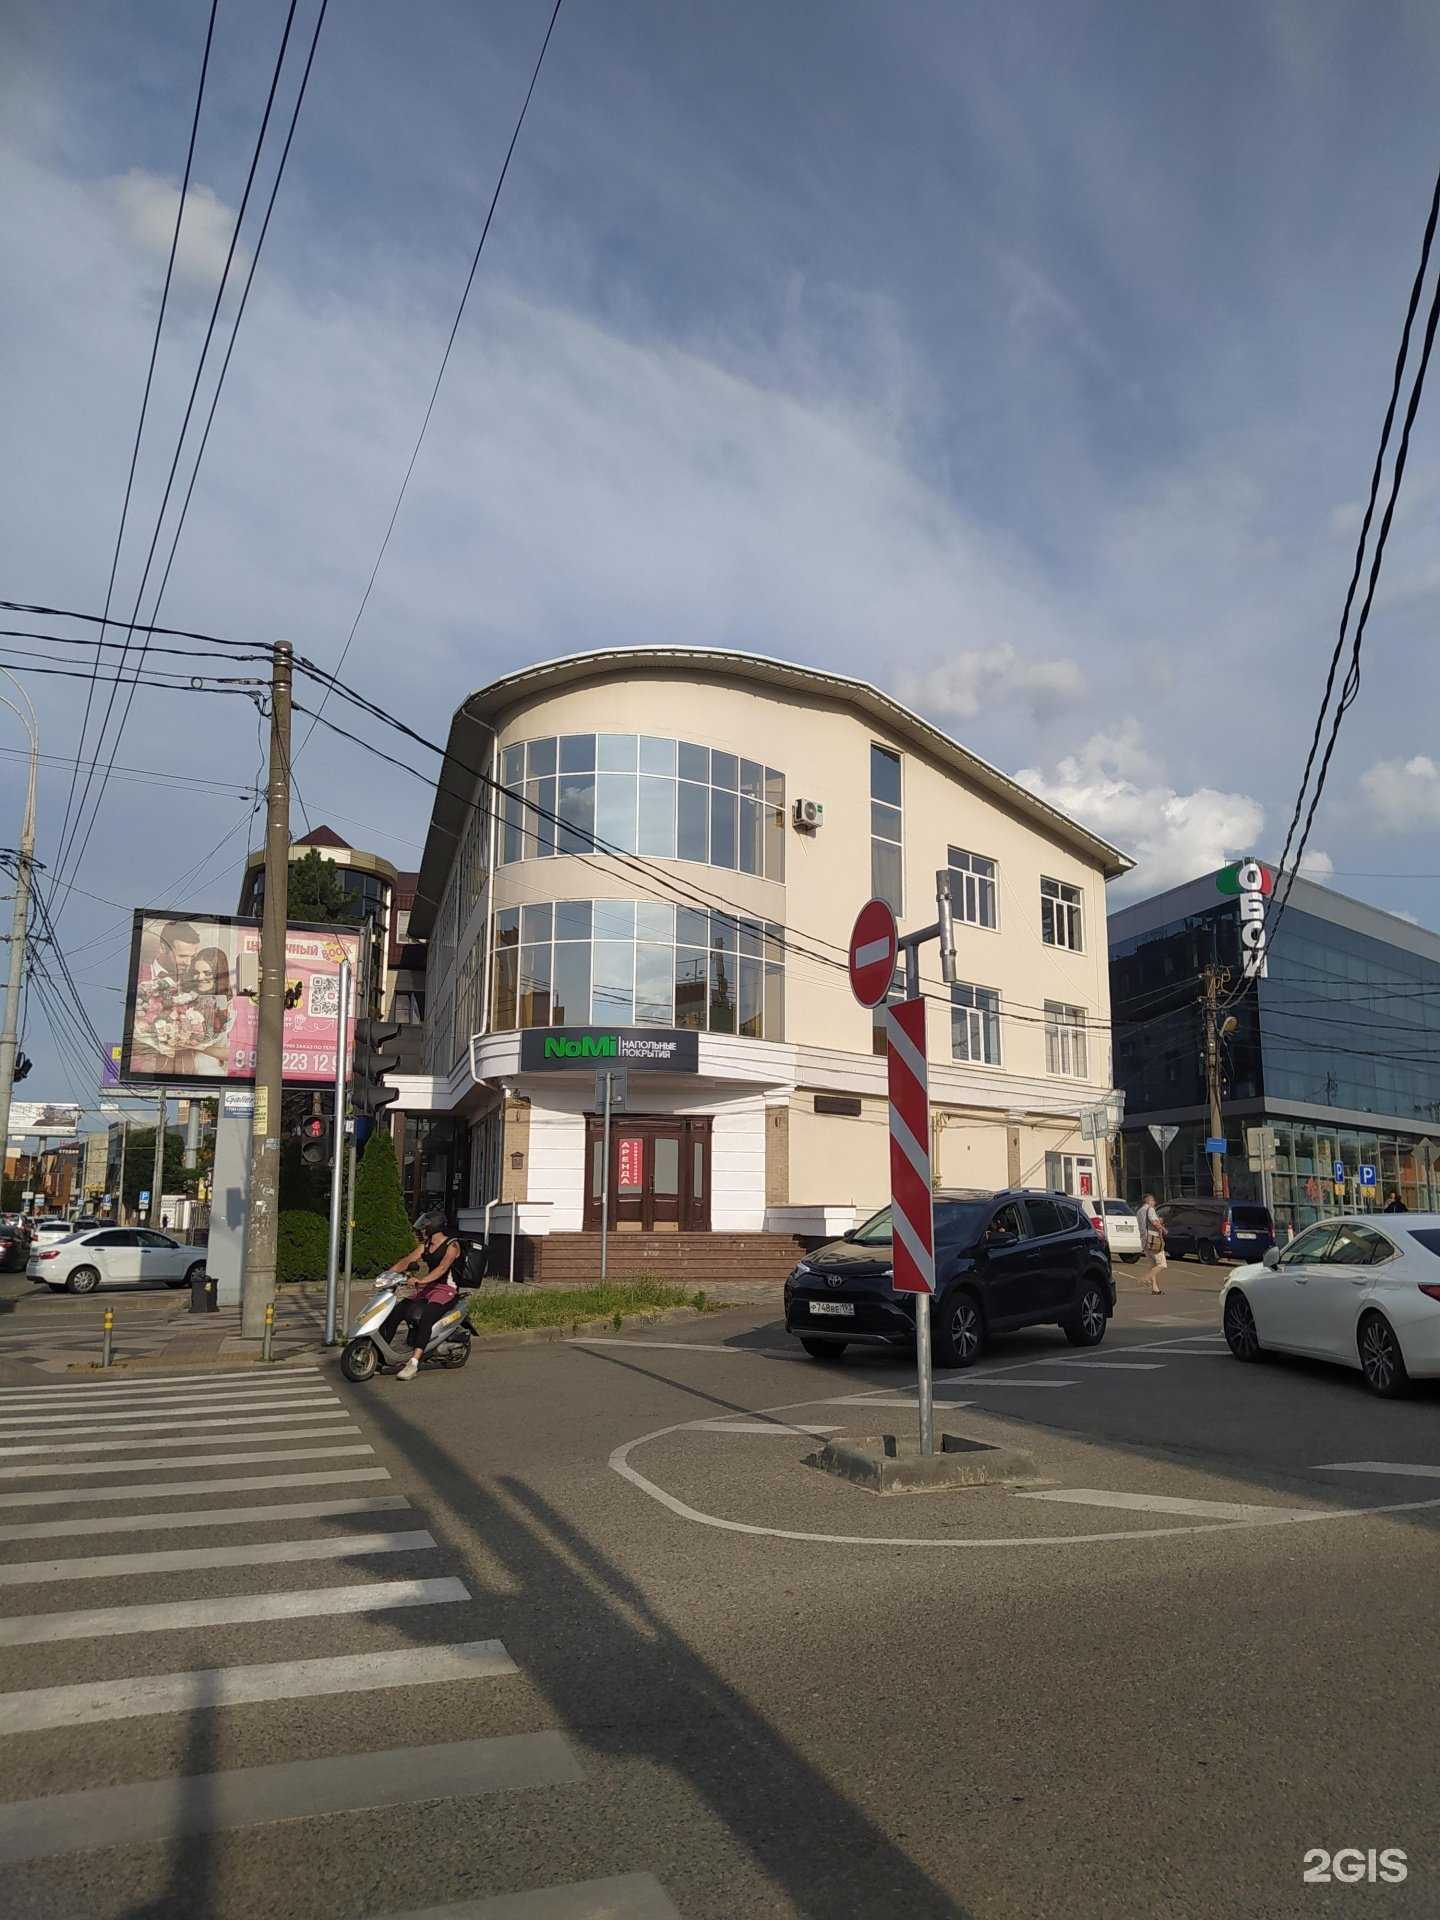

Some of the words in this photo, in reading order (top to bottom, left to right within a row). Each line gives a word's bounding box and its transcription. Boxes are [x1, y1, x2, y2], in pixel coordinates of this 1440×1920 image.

[543, 1036, 617, 1058] NoMi
[622, 1039, 677, 1051] НАПОЛЬНЫЕ
[622, 1048, 671, 1059] ПОКРЫТИЯ
[313, 1054, 329, 1072] 12
[620, 1142, 630, 1184] АРЕНДА
